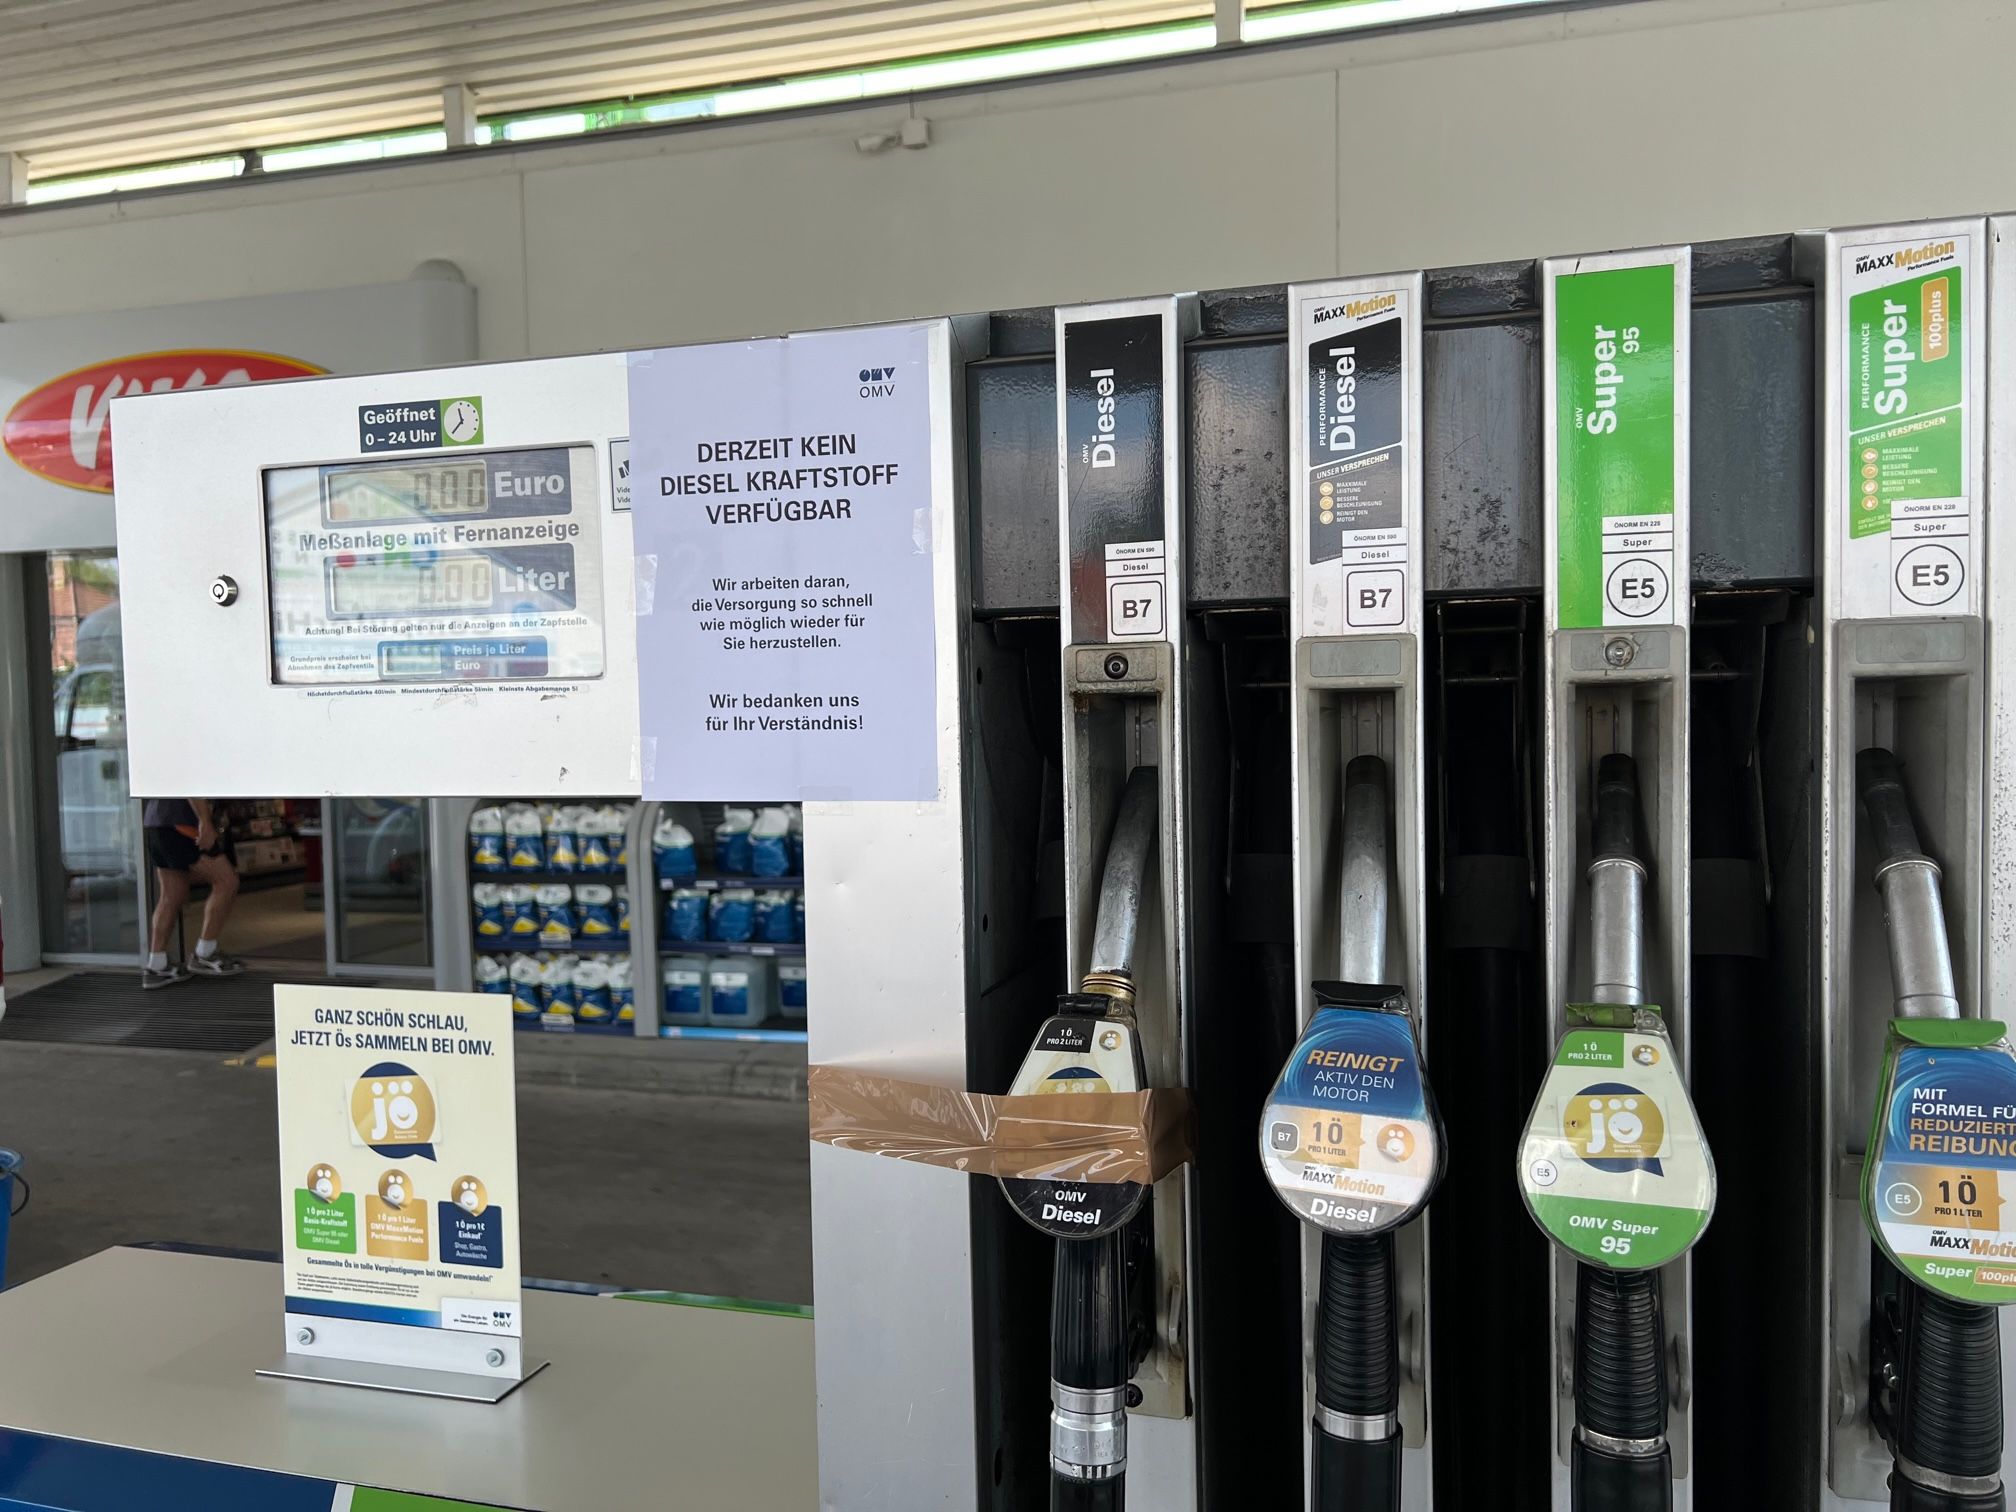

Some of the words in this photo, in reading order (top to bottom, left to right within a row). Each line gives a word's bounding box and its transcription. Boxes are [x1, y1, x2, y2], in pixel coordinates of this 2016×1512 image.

[1929, 290, 1944, 350] 100plus
[1622, 326, 1640, 354] 95
[1862, 322, 1870, 408] PERFORMANCE
[1874, 299, 1916, 415] Super
[1586, 325, 1624, 435] Super
[860, 384, 896, 398] OMV
[1329, 346, 1356, 451] Diesel
[364, 407, 436, 424] Geöffnet
[1090, 368, 1116, 468] Diesel
[1576, 407, 1584, 429] OMV
[366, 433, 374, 446] 0
[388, 432, 406, 444] 24
[410, 430, 436, 442] Uhr
[1858, 432, 1886, 445] UNSER
[1888, 416, 1946, 438] VERSPRECHEN
[697, 437, 794, 463] DERZEIT
[801, 434, 856, 457] KEIN
[1317, 467, 1340, 479] UNSER
[1340, 453, 1390, 473] VERSPRECHEN
[494, 472, 565, 498] Euro
[660, 472, 740, 496] DIESEL
[746, 464, 898, 492] KRAFTSTOFF
[706, 498, 852, 525] VERFÜGBAR
[1904, 505, 1931, 513] ÖNORM
[300, 530, 408, 550] Meßanlage
[414, 526, 447, 545] mit
[454, 520, 580, 542] Fernanzeige
[1914, 524, 1947, 532] Super
[1623, 539, 1652, 547] Super
[1361, 550, 1390, 559] Diesel
[1123, 563, 1149, 571] Diesel
[1912, 564, 1950, 587] E5
[499, 566, 570, 592] Liter
[712, 578, 737, 591] Wir
[741, 577, 799, 590] arbeiten
[804, 575, 850, 589] daran,
[1622, 578, 1655, 599] E5
[691, 598, 712, 611] die
[715, 598, 796, 612] Versorgung
[801, 597, 817, 608] so
[822, 594, 873, 608] schnell
[1359, 588, 1393, 609] B7
[1122, 599, 1152, 618] B7
[306, 626, 344, 636] Achtung!
[346, 626, 360, 634] Bei
[363, 624, 398, 634] Störung
[400, 624, 428, 633] gelten
[430, 622, 445, 630] nur
[448, 621, 462, 630] die
[464, 620, 506, 630] Anzeigen
[522, 619, 538, 627] der
[540, 618, 588, 629] Zapfstelle
[700, 618, 725, 631] wie
[730, 616, 786, 632] möglich
[790, 615, 840, 629] wieder
[844, 614, 865, 627] für
[454, 645, 482, 655] Preis
[486, 645, 496, 656] je
[500, 644, 526, 654] Liter
[723, 636, 745, 650] Sie
[750, 635, 841, 649] herzustellen.
[454, 660, 480, 670] Euro
[709, 694, 738, 708] Wir
[743, 693, 823, 708] bedanken
[829, 695, 860, 707] uns
[705, 716, 728, 731] für
[733, 716, 755, 731] Ihr
[758, 715, 863, 731] Verständnis!
[314, 1008, 353, 1025] GANZ
[357, 1009, 404, 1028] SCHÖN
[408, 1013, 468, 1033] SCHLAU,
[1060, 1029, 1065, 1037] 1
[1066, 1027, 1072, 1037] Ö
[291, 1030, 332, 1047] JETZT
[335, 1028, 352, 1048] Ös
[356, 1033, 427, 1052] SAMMELN
[432, 1038, 454, 1054] BEI
[459, 1039, 495, 1056] OMV.
[1046, 1037, 1060, 1045] PRO
[1065, 1038, 1083, 1046] LITER
[1590, 1041, 1597, 1051] Ö
[1306, 1049, 1404, 1072] REINIGT
[1591, 1053, 1612, 1061] LITER
[1314, 1070, 1358, 1085] AKTIV
[1362, 1074, 1395, 1089] DEN
[1312, 1085, 1369, 1103] MOTOR
[1913, 1087, 1947, 1101] MIT
[1911, 1102, 1987, 1118] FORMEL
[1278, 1131, 1291, 1142] B7
[1313, 1122, 1321, 1142] 1
[1328, 1117, 1343, 1145] Ö
[1308, 1145, 1322, 1154] PRO
[1322, 1146, 1327, 1154] 1
[1327, 1147, 1346, 1157] LITER
[1537, 1168, 1550, 1177] E5
[1055, 1190, 1087, 1203] OMV
[1894, 1194, 1911, 1204] E5
[1938, 1180, 1949, 1204] 1
[1958, 1175, 1977, 1205] Ö
[1041, 1204, 1101, 1225] Diesel
[1310, 1199, 1378, 1223] Diesel
[1934, 1207, 1951, 1215] PRO
[1569, 1215, 1607, 1230] OMV
[1611, 1219, 1659, 1236] Super
[1599, 1236, 1631, 1255] 95
[307, 1257, 343, 1268] Gesammelte
[354, 1261, 359, 1269] in
[436, 1270, 452, 1278] OMV
[1924, 1262, 1973, 1278] Super
[493, 1320, 512, 1328] OMV
